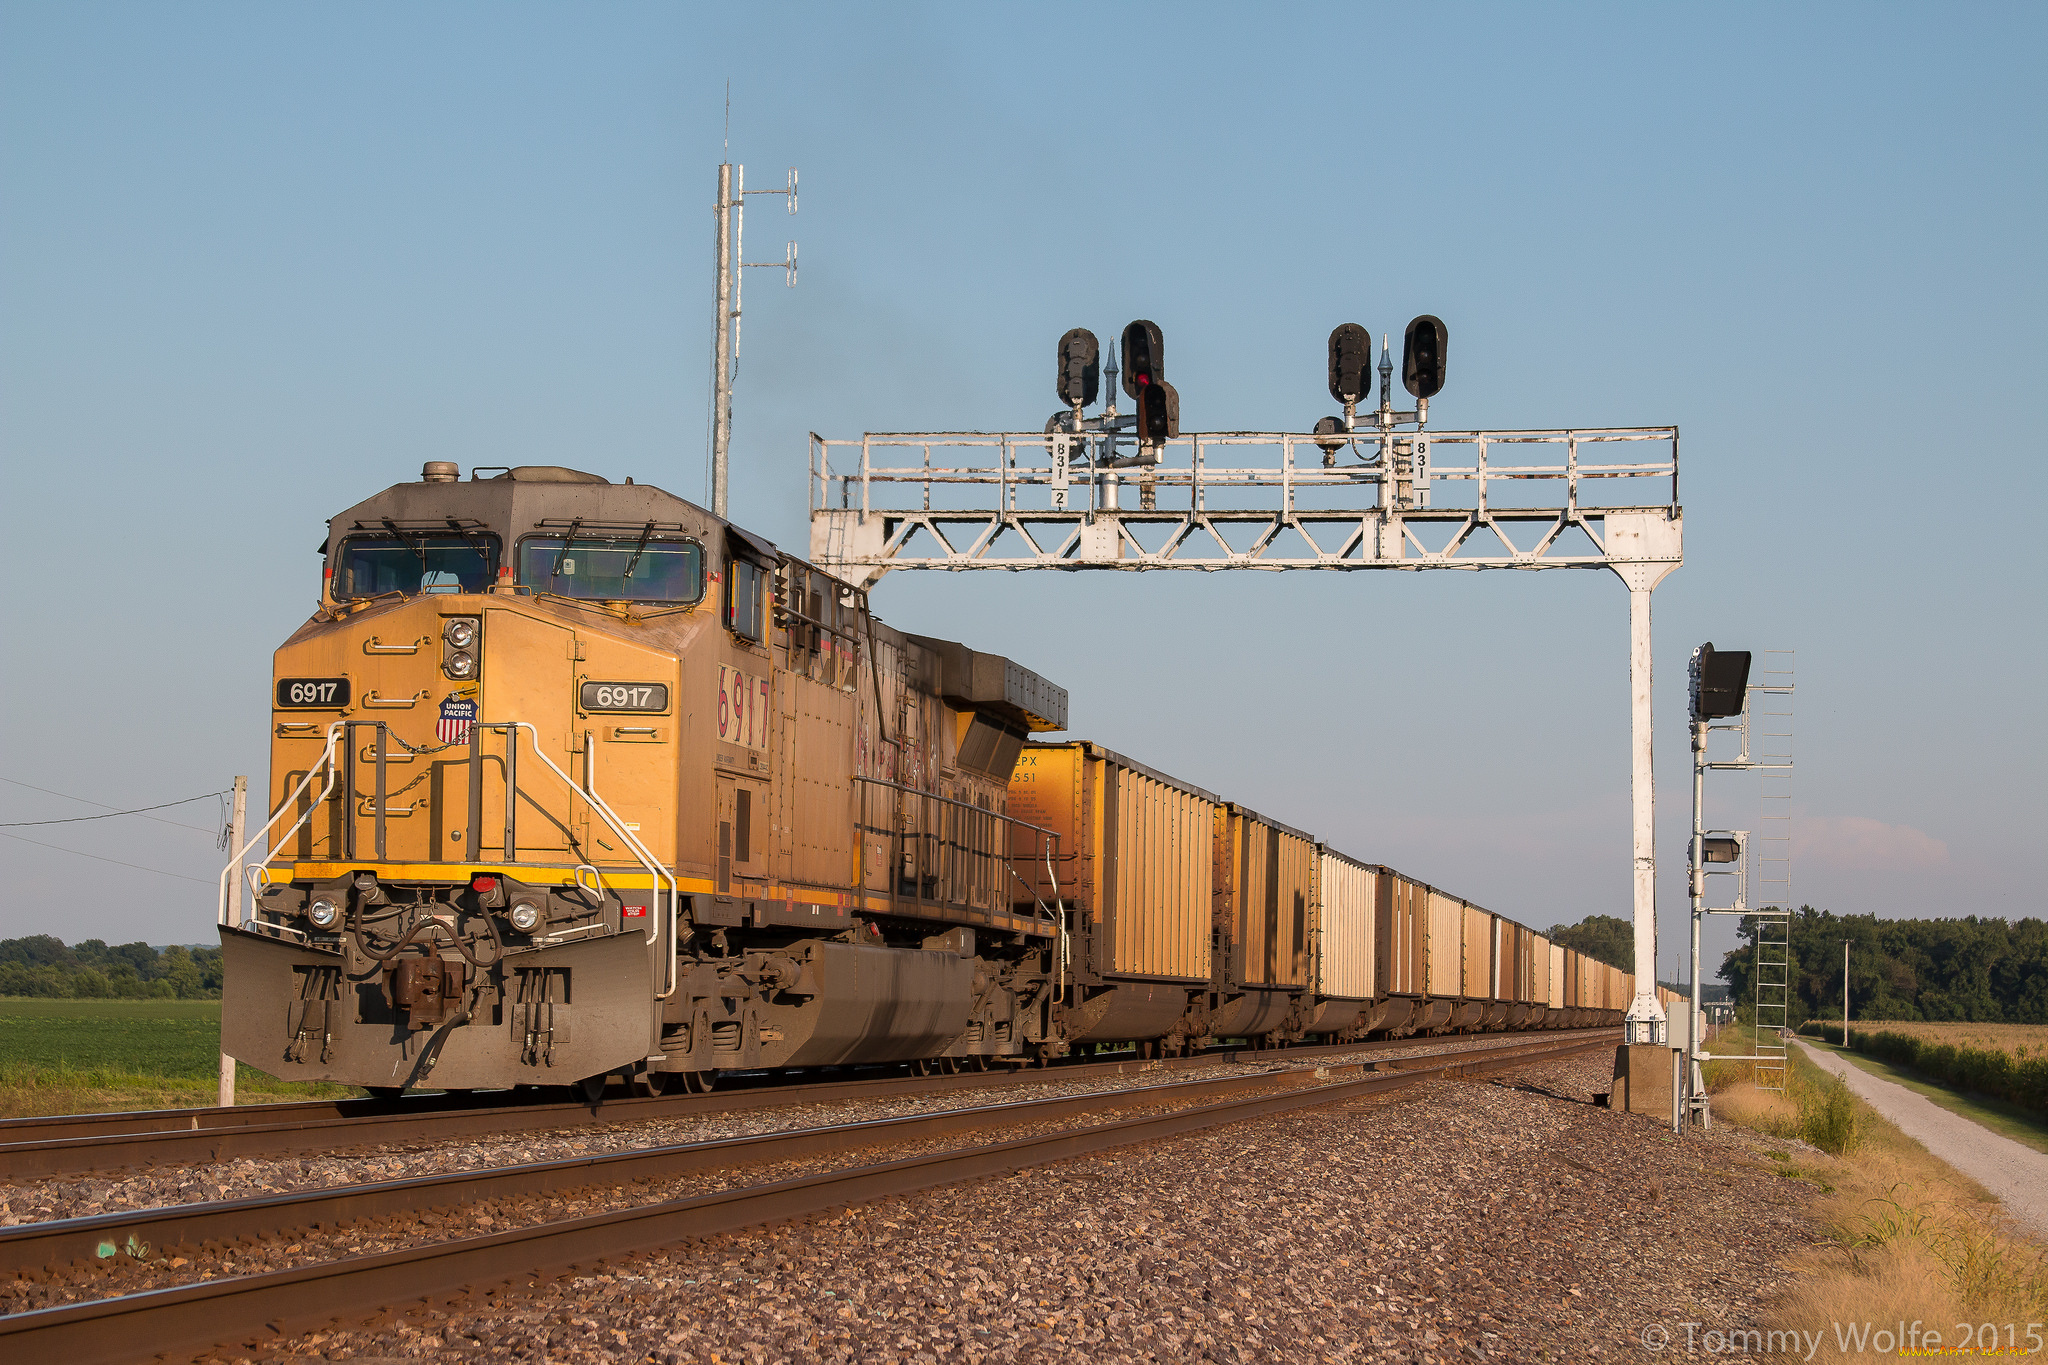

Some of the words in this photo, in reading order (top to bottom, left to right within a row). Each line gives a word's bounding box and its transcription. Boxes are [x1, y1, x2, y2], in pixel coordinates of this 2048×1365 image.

[1057, 443, 1065, 479] 831
[1418, 442, 1426, 479] 831
[1056, 492, 1064, 504] 2
[290, 683, 337, 703] 6917
[597, 686, 653, 707] 6917
[444, 709, 473, 717] PACIFIC
[718, 666, 769, 748] 6917
